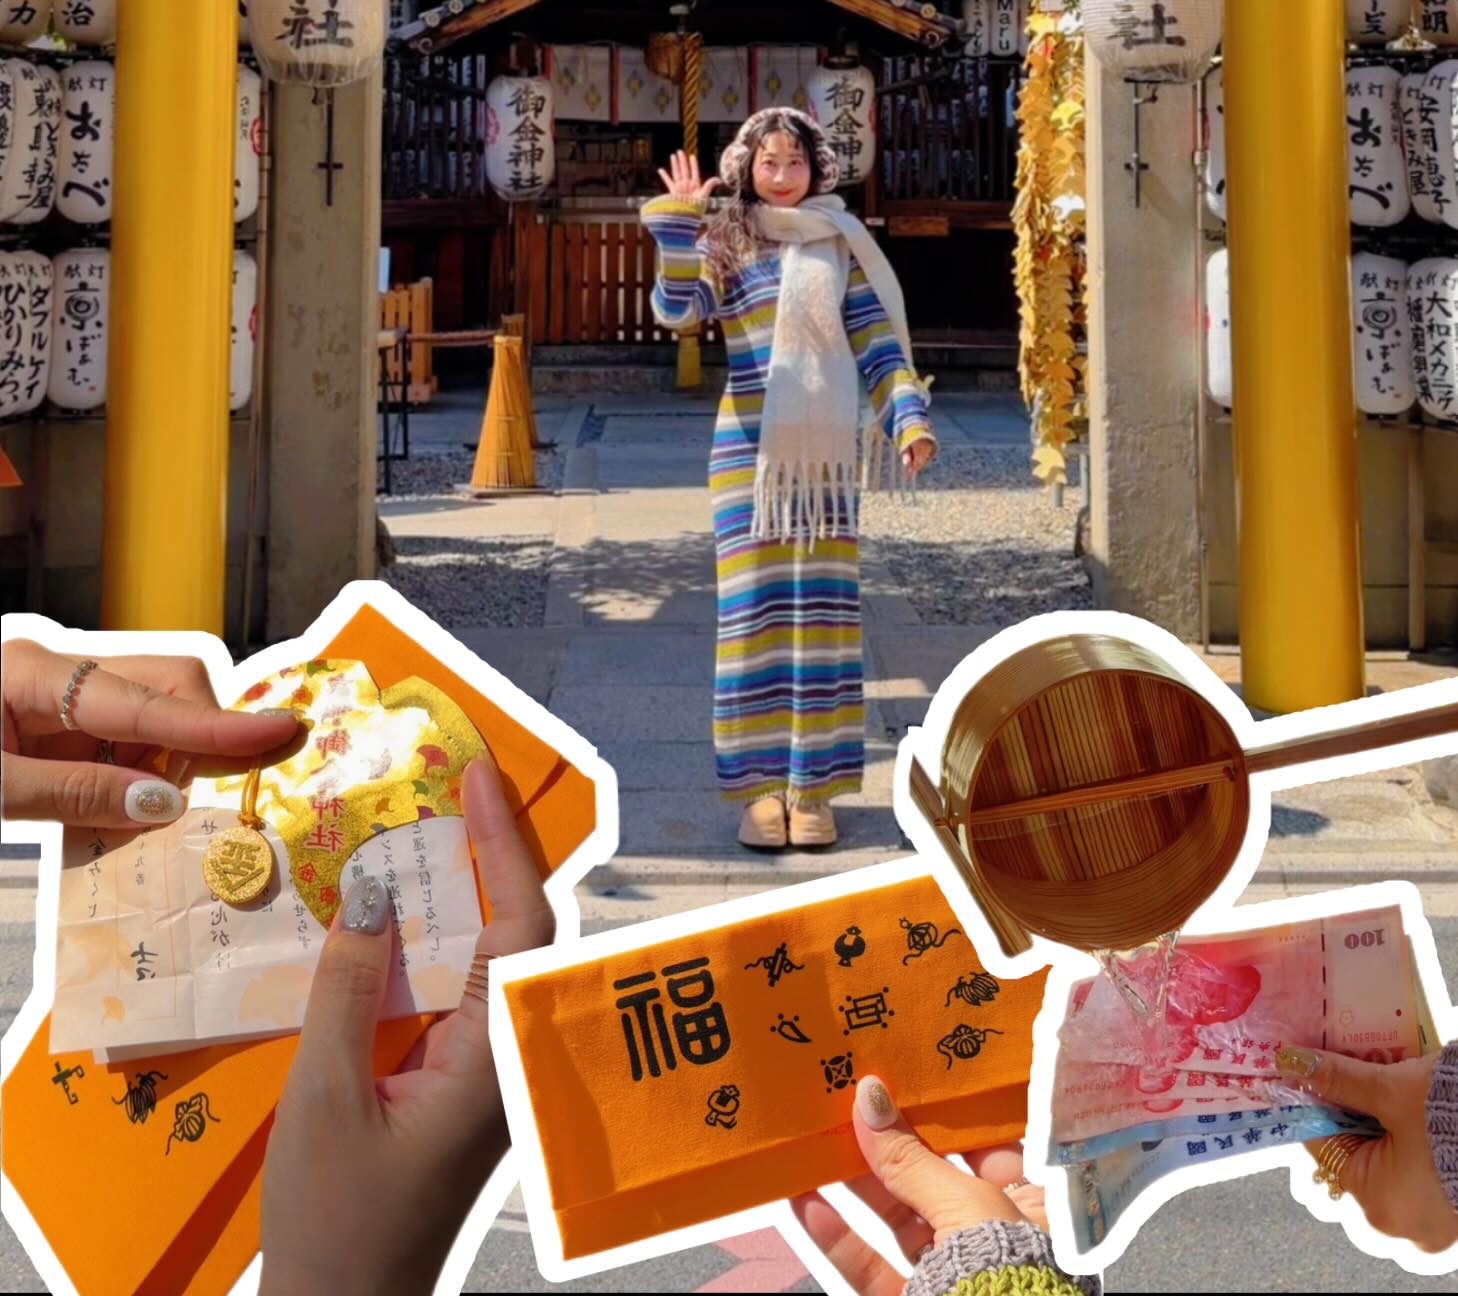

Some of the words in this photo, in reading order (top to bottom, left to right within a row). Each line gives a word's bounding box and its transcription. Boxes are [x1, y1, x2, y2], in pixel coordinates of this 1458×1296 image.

[506, 86, 546, 192] 御金神社
[1344, 929, 1385, 950] 100
[613, 957, 732, 1082] 福
[1186, 1122, 1289, 1156] 中華民國
